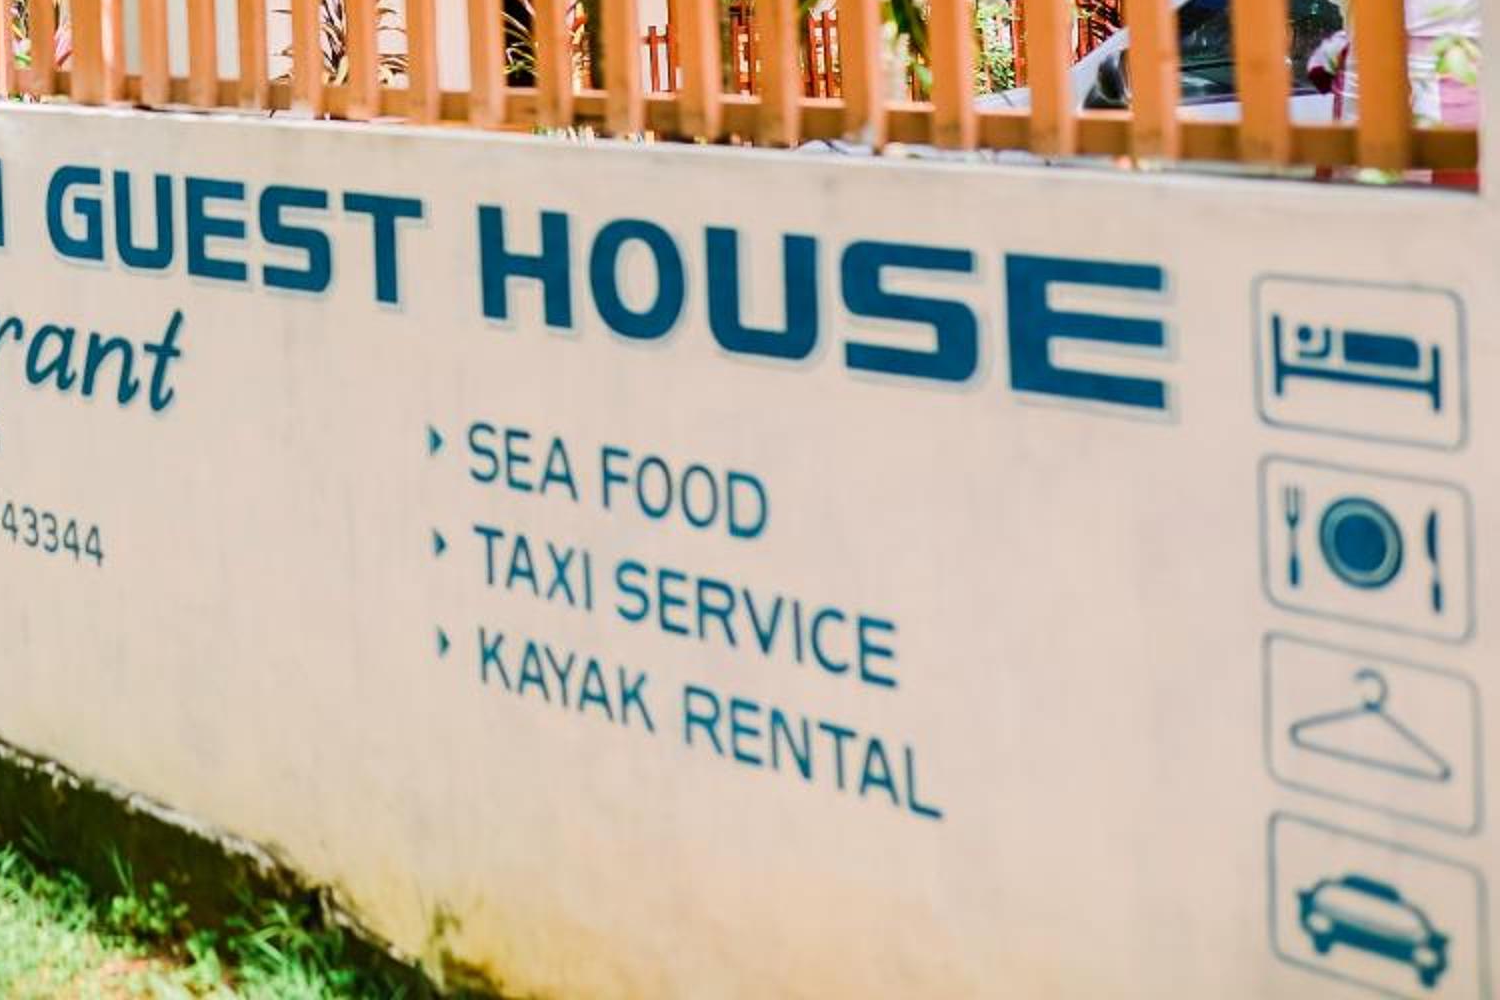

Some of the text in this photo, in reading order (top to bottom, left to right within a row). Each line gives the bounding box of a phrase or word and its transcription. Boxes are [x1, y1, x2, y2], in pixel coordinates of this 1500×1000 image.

[45, 164, 424, 305] GUEST
[477, 204, 1167, 411] HOUSE
[467, 421, 769, 541] SEA FOOD
[472, 524, 898, 690] TAXI SERVICE
[478, 626, 944, 821] KAYAK RENTAL
